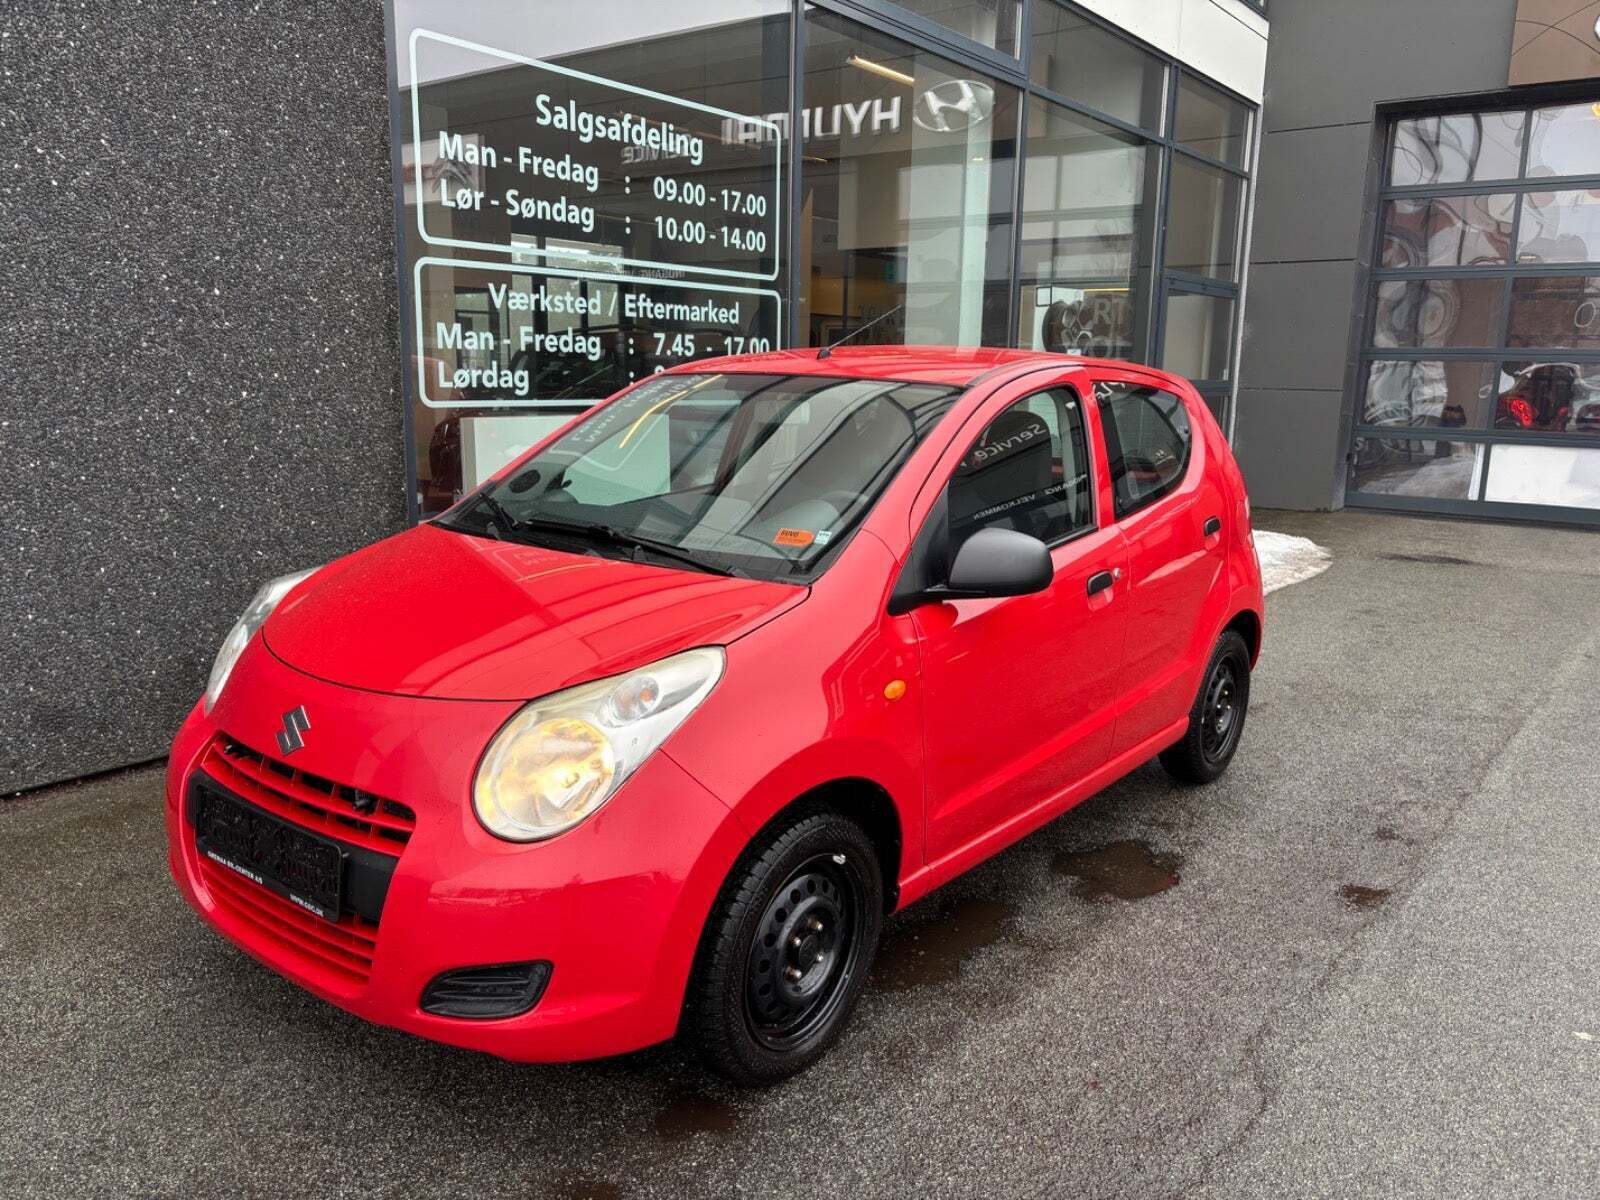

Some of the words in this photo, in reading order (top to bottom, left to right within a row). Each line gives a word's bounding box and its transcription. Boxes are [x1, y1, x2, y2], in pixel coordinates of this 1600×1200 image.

[535, 94, 704, 165] Salgsafdeling
[439, 130, 497, 168] Man
[518, 147, 599, 192] Fredag
[653, 176, 706, 206] 09.00
[720, 188, 767, 217] 17.00
[440, 178, 485, 211] Lør
[506, 189, 595, 232] Søndag
[654, 215, 706, 244] 10.00
[720, 225, 767, 253] 14.00
[488, 283, 602, 316] Værksted
[608, 291, 618, 318] /
[624, 293, 740, 325] Eftermarked
[436, 322, 495, 351] Man
[519, 323, 601, 360] Fredag
[653, 332, 695, 357] 7.45
[438, 361, 530, 395] Lørdag
